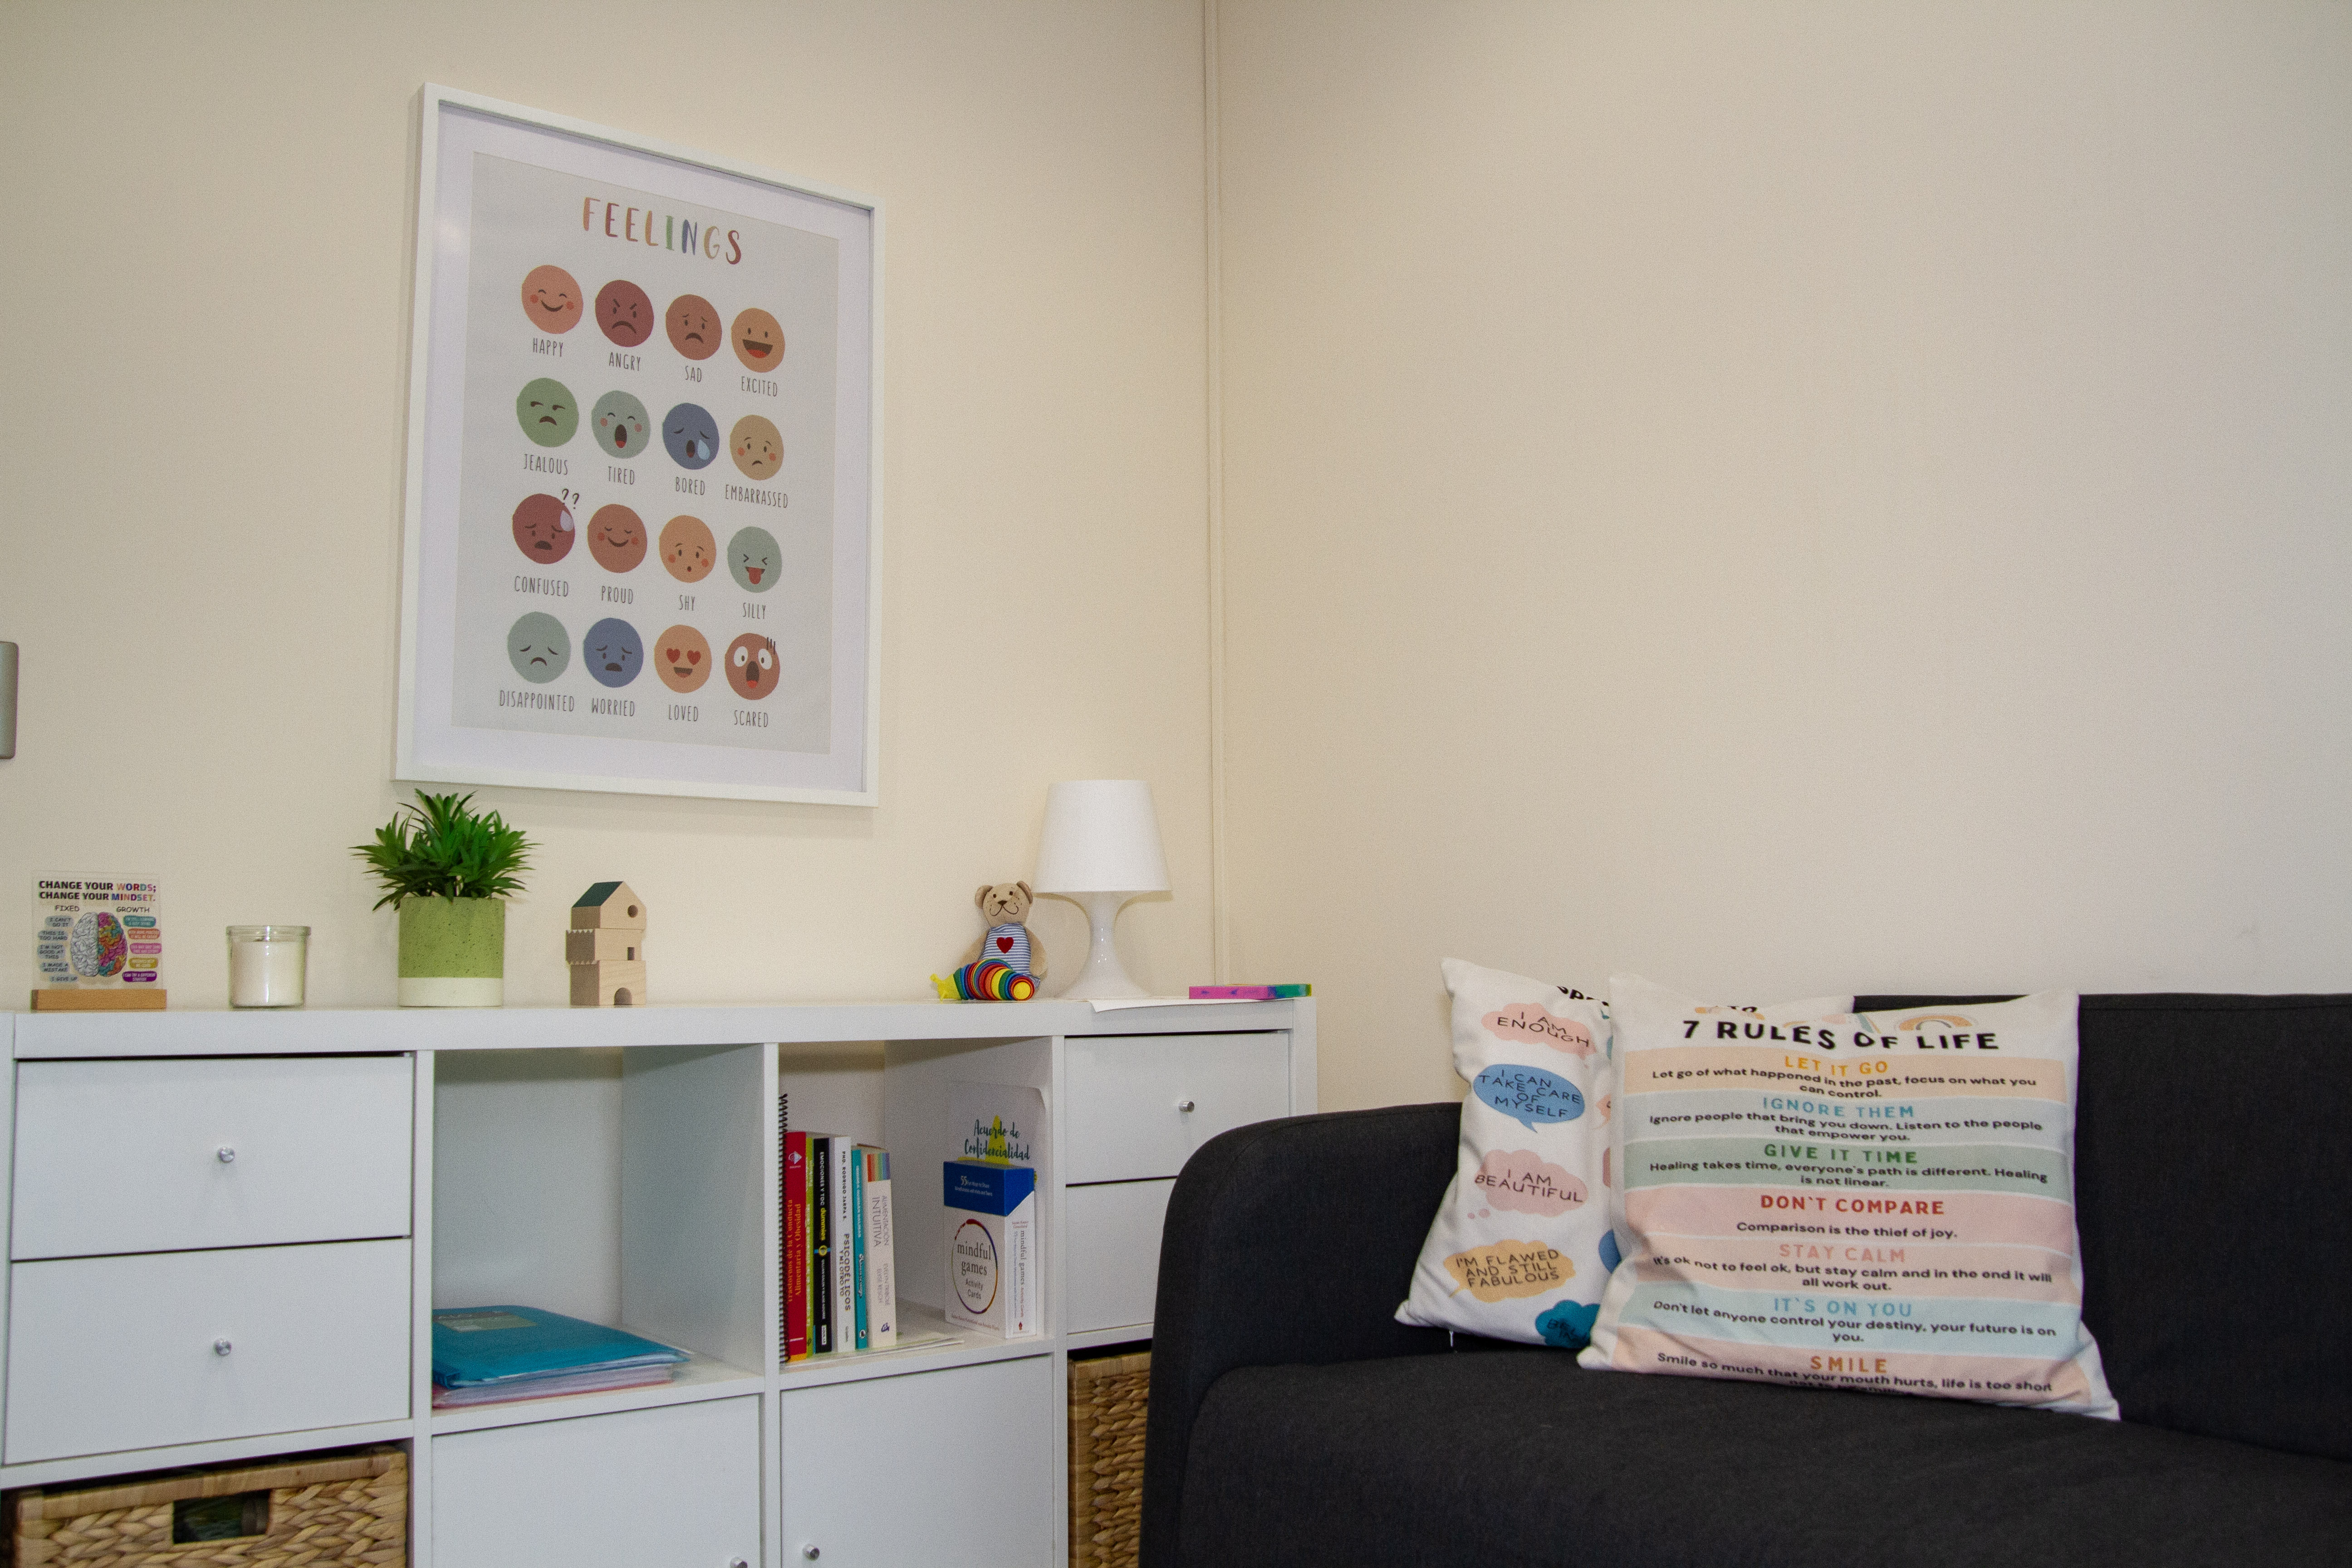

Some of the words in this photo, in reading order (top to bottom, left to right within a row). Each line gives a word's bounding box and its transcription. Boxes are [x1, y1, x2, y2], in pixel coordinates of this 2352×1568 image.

[582, 197, 742, 265] FEELINGS
[533, 338, 564, 358] HAPPY
[609, 352, 641, 372] ANGRY
[685, 366, 702, 383] SAD
[741, 377, 779, 397] EXCITED
[523, 454, 568, 475] JEALOUS
[608, 466, 635, 485] TIRED
[675, 477, 706, 496] BORED
[725, 484, 789, 509] EMBARRASSED
[514, 576, 569, 597] CONFUSED
[601, 585, 634, 605] PROUD
[679, 595, 696, 611] SHY
[742, 603, 766, 620] SILLY
[500, 690, 575, 713] DISAPPOINTED
[592, 698, 635, 717] WORRIED
[668, 705, 699, 722] LOVED
[734, 710, 769, 728] SCARED
[39, 881, 82, 889] CHANGE
[117, 883, 156, 893] WORDS;
[112, 893, 155, 901] MINDSET.
[1497, 1017, 1588, 1047] ENOUGH
[1538, 1017, 1566, 1034] AM
[1684, 1020, 1699, 1038] 7
[1717, 1021, 1836, 1050] RULES
[1854, 1031, 1898, 1049] OF
[1916, 1033, 1999, 1049] LIFE
[1785, 1056, 1821, 1071] LET
[1831, 1065, 1849, 1077] IT
[1860, 1061, 1888, 1075] GO
[1514, 1074, 1551, 1088] CAN
[1652, 1071, 1673, 1079] Let
[1677, 1071, 1692, 1079] go
[1751, 1068, 1820, 1083] happened
[1825, 1078, 1836, 1086] in
[1866, 1079, 1901, 1088] past,
[1970, 1077, 2005, 1085] what
[2010, 1078, 2036, 1086] you
[1479, 1075, 1525, 1092] TAKE
[1536, 1088, 1580, 1103] CARE
[1517, 1093, 1540, 1103] OF
[1800, 1085, 1824, 1095] can
[1828, 1089, 1882, 1098] control.
[1495, 1096, 1567, 1117] MYSELF
[1764, 1098, 1845, 1117] IGNORE
[1856, 1106, 1914, 1118] THEM
[974, 1119, 1007, 1139] Acuerdo
[1010, 1122, 1020, 1138] de
[1650, 1115, 1691, 1125] Ignore
[1695, 1112, 1742, 1122] people
[1747, 1112, 1775, 1121] that
[1780, 1114, 1815, 1127] bring
[1850, 1122, 1892, 1130] down.
[1896, 1122, 1941, 1130] Listen
[1992, 1121, 2042, 1131] people
[1776, 1125, 1804, 1136] that
[1809, 1129, 1875, 1141] empower
[965, 1137, 1030, 1160] Confidencialidad
[1764, 1144, 1818, 1159] GIVE
[1831, 1148, 1850, 1161] IT
[1863, 1151, 1917, 1164] TIME
[1523, 1173, 1552, 1186] AM
[1650, 1161, 1698, 1172] Healing
[1703, 1161, 1741, 1170] takes
[1746, 1161, 1781, 1171] time,
[1785, 1164, 1863, 1175] everyone's
[1867, 1167, 1901, 1176] path
[1922, 1168, 1990, 1176] different.
[1994, 1168, 2048, 1183] Healing
[1801, 1175, 1812, 1184] is
[1816, 1177, 1840, 1185] not
[1844, 1177, 1889, 1187] linear.
[1475, 1175, 1583, 1202] BEAUTIFUL
[1835, 1198, 1945, 1215] COMPARE
[872, 1197, 882, 1247] INTUITIVA
[1737, 1222, 1825, 1234] Comparison
[1829, 1225, 1841, 1234] is
[1846, 1227, 1869, 1236] the
[1874, 1228, 1908, 1237] thief
[1912, 1228, 1926, 1237] of
[1930, 1229, 1957, 1239] joy.
[957, 1241, 991, 1260] mindful
[1456, 1257, 1478, 1267] I'M
[1486, 1249, 1558, 1265] FLAWED
[1779, 1244, 1833, 1259] STAY
[1845, 1248, 1905, 1263] CALM
[961, 1261, 987, 1275] games
[1466, 1266, 1499, 1278] AND
[1508, 1262, 1557, 1274] STILL
[965, 1279, 983, 1291] Activity
[1467, 1271, 1559, 1287] FABULOUS
[840, 1287, 844, 1297] YO
[968, 1289, 981, 1299] Cards
[1827, 1300, 1857, 1315] ON
[1867, 1303, 1912, 1317] YOU
[1654, 1301, 1687, 1313] Don't
[1691, 1306, 1709, 1315] let
[1714, 1310, 1766, 1323] anyone
[1771, 1316, 1824, 1326] control
[1828, 1319, 1862, 1329] your
[1866, 1320, 1926, 1332] destiny,
[1931, 1323, 1965, 1333] your
[1970, 1323, 2017, 1334] future
[2021, 1326, 2034, 1335] is
[2038, 1328, 2056, 1336] on
[1833, 1332, 1864, 1343] you.
[1811, 1356, 1887, 1374] SMILE
